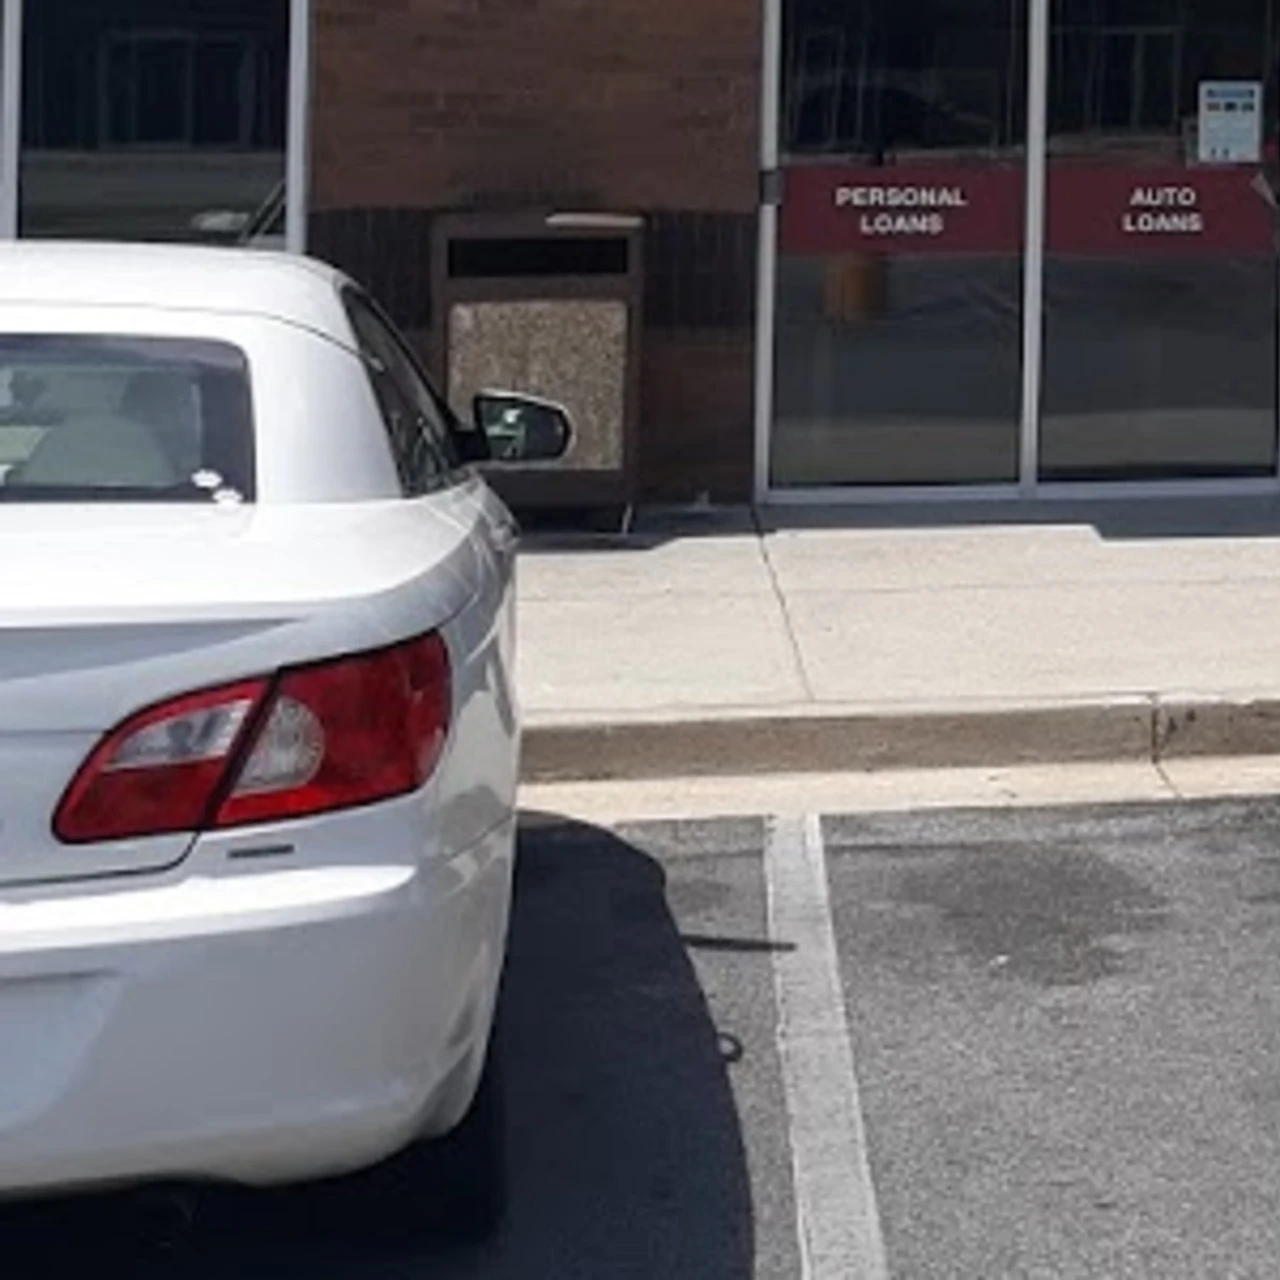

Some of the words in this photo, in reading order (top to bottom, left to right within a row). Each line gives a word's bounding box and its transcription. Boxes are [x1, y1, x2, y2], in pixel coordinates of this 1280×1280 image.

[835, 187, 967, 206] PERSONAL
[1130, 188, 1196, 206] AUTO
[860, 214, 944, 234] LOANS
[1123, 214, 1202, 233] LOANS
